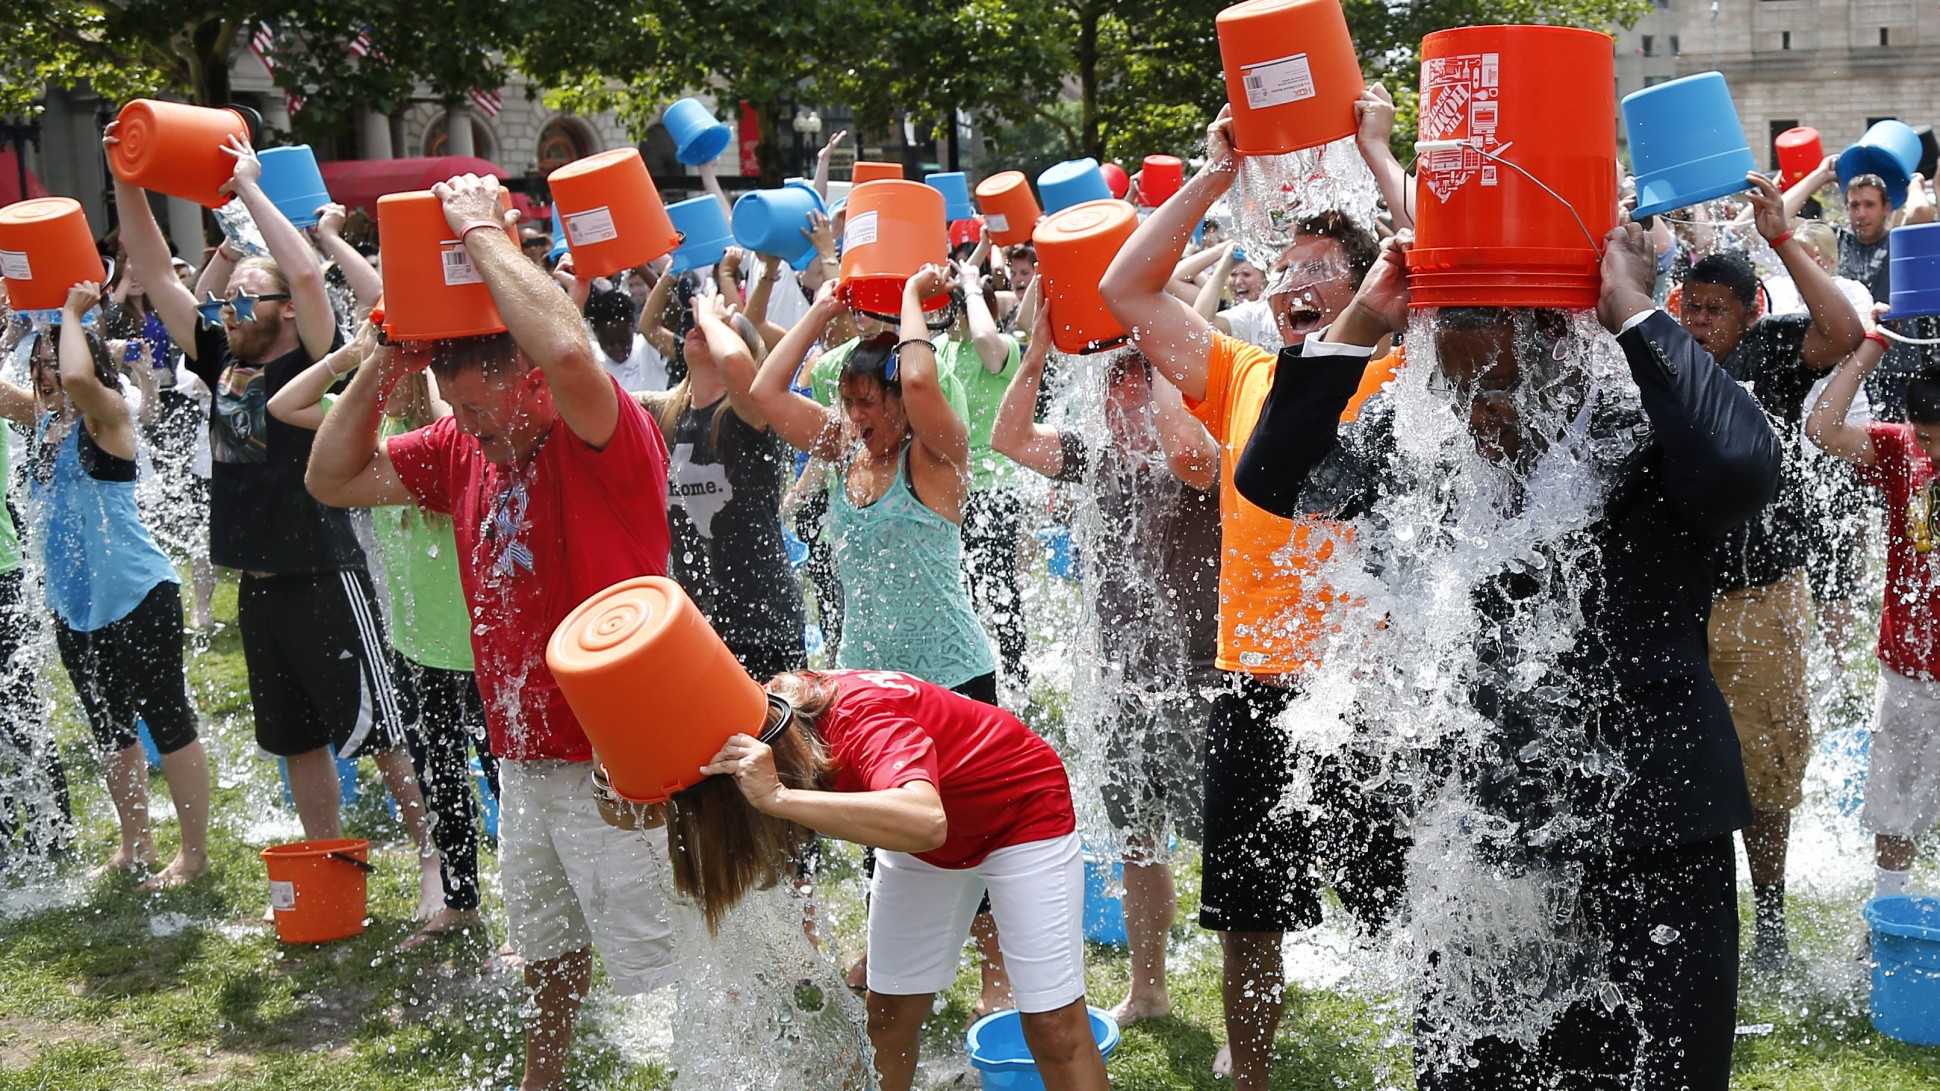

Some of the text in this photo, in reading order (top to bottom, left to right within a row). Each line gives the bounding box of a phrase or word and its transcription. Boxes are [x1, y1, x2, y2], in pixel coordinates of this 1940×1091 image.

[1430, 85, 1451, 122] DEPOT
[1430, 84, 1470, 139] HOME
[1446, 112, 1465, 136] THE
[668, 481, 723, 497] home.
